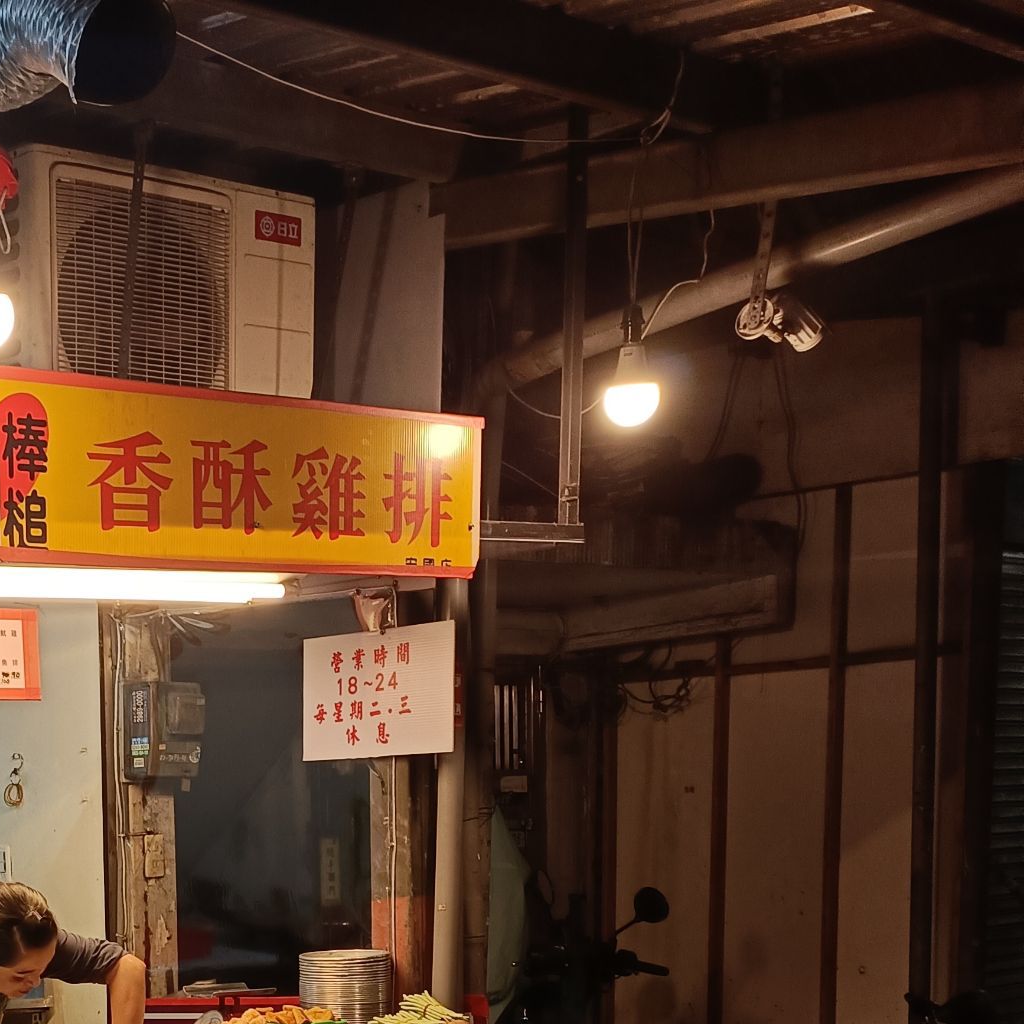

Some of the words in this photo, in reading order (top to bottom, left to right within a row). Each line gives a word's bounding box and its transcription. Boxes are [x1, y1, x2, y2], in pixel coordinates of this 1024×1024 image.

[277, 221, 299, 239] 日立
[86, 430, 454, 549] 香酥雞排
[330, 642, 410, 673] 營業時間
[337, 671, 398, 696] 18~24
[346, 721, 390, 746] 休息
